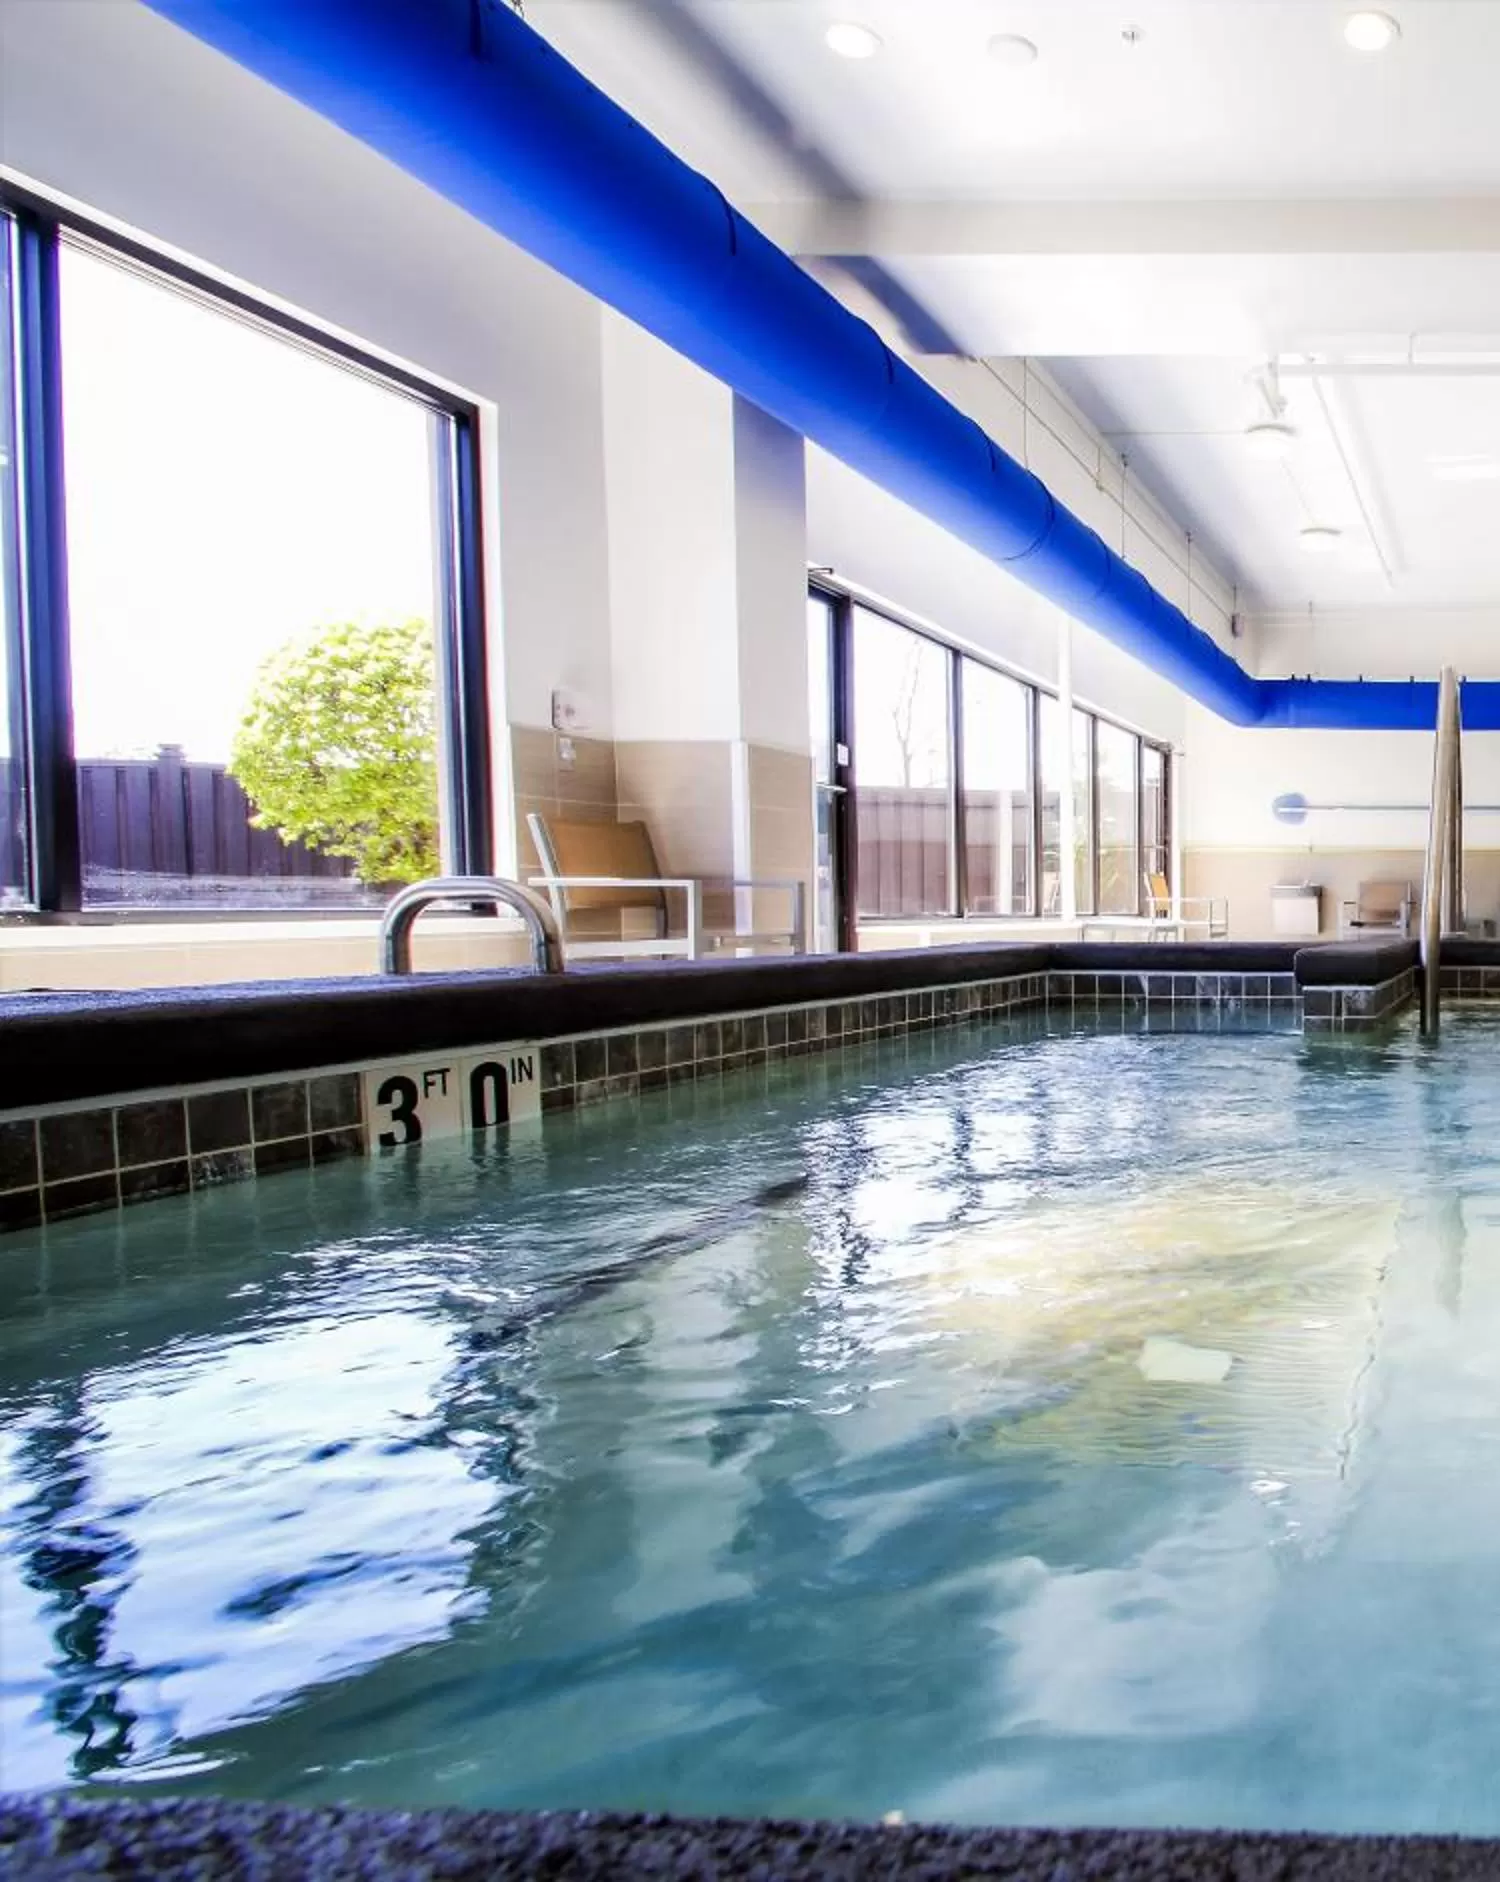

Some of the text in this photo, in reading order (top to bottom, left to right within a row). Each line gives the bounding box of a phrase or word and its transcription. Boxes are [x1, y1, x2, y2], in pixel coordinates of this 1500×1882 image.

[377, 1075, 422, 1147] 3
[423, 1067, 451, 1098] FT
[511, 1055, 533, 1084] IN
